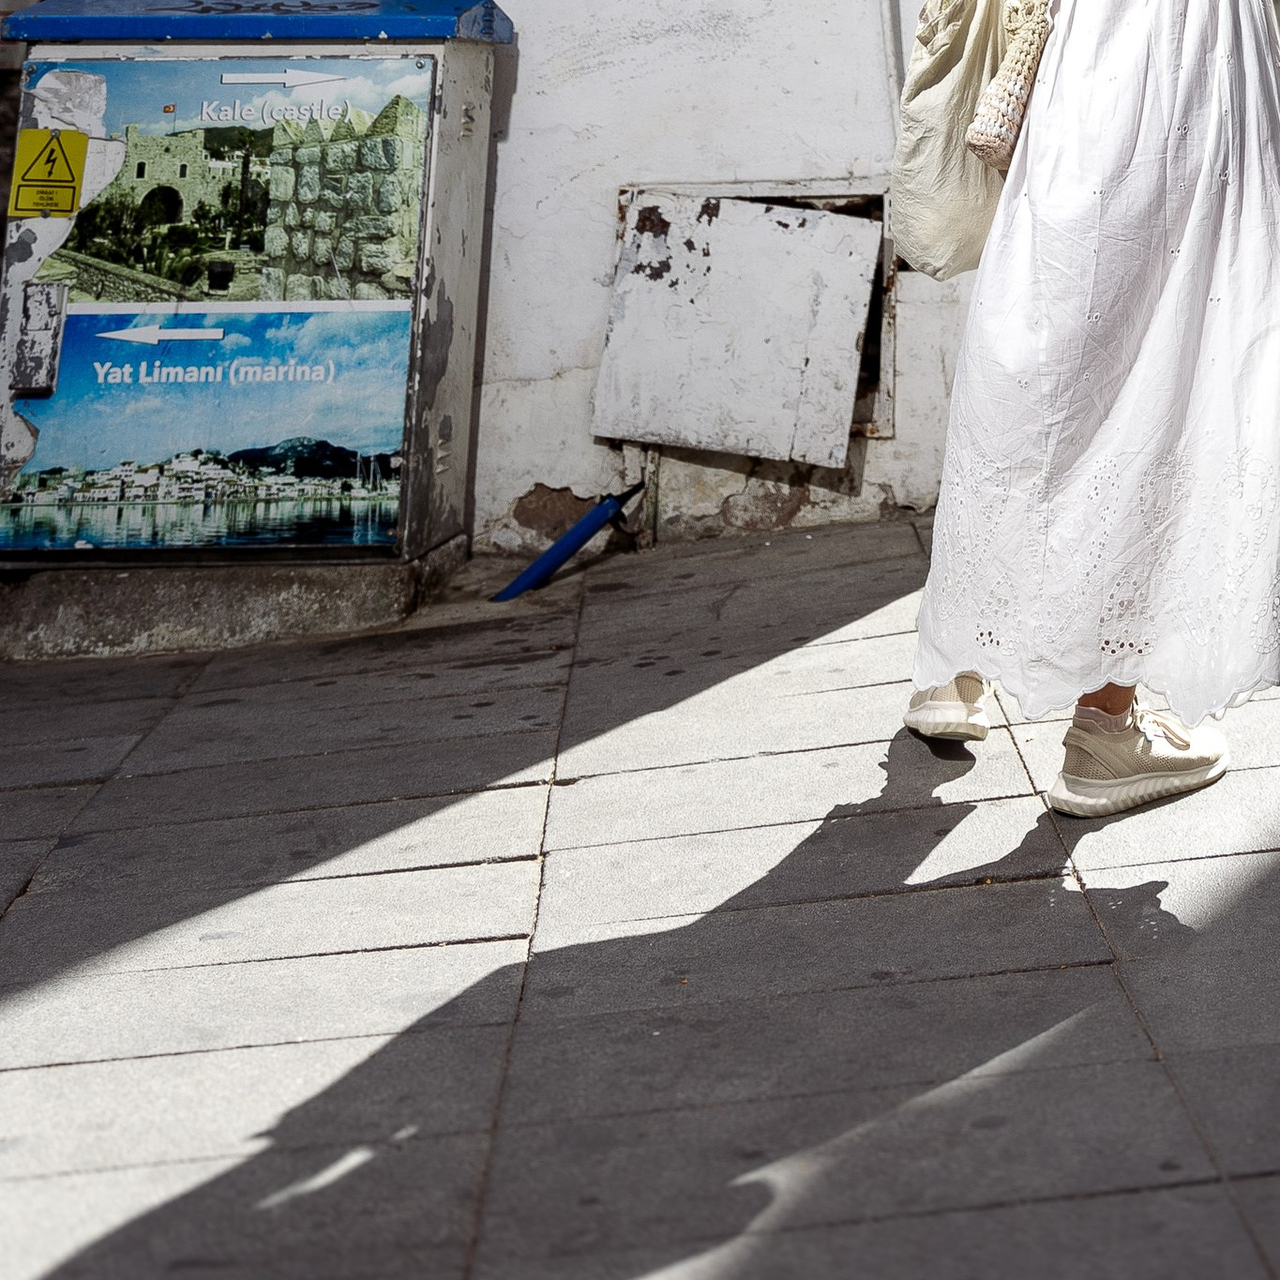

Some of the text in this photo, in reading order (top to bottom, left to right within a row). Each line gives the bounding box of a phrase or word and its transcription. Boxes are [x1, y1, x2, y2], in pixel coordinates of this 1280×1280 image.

[200, 98, 351, 125] Kale (castle)
[93, 358, 336, 385] Yat Limanı (marina)
